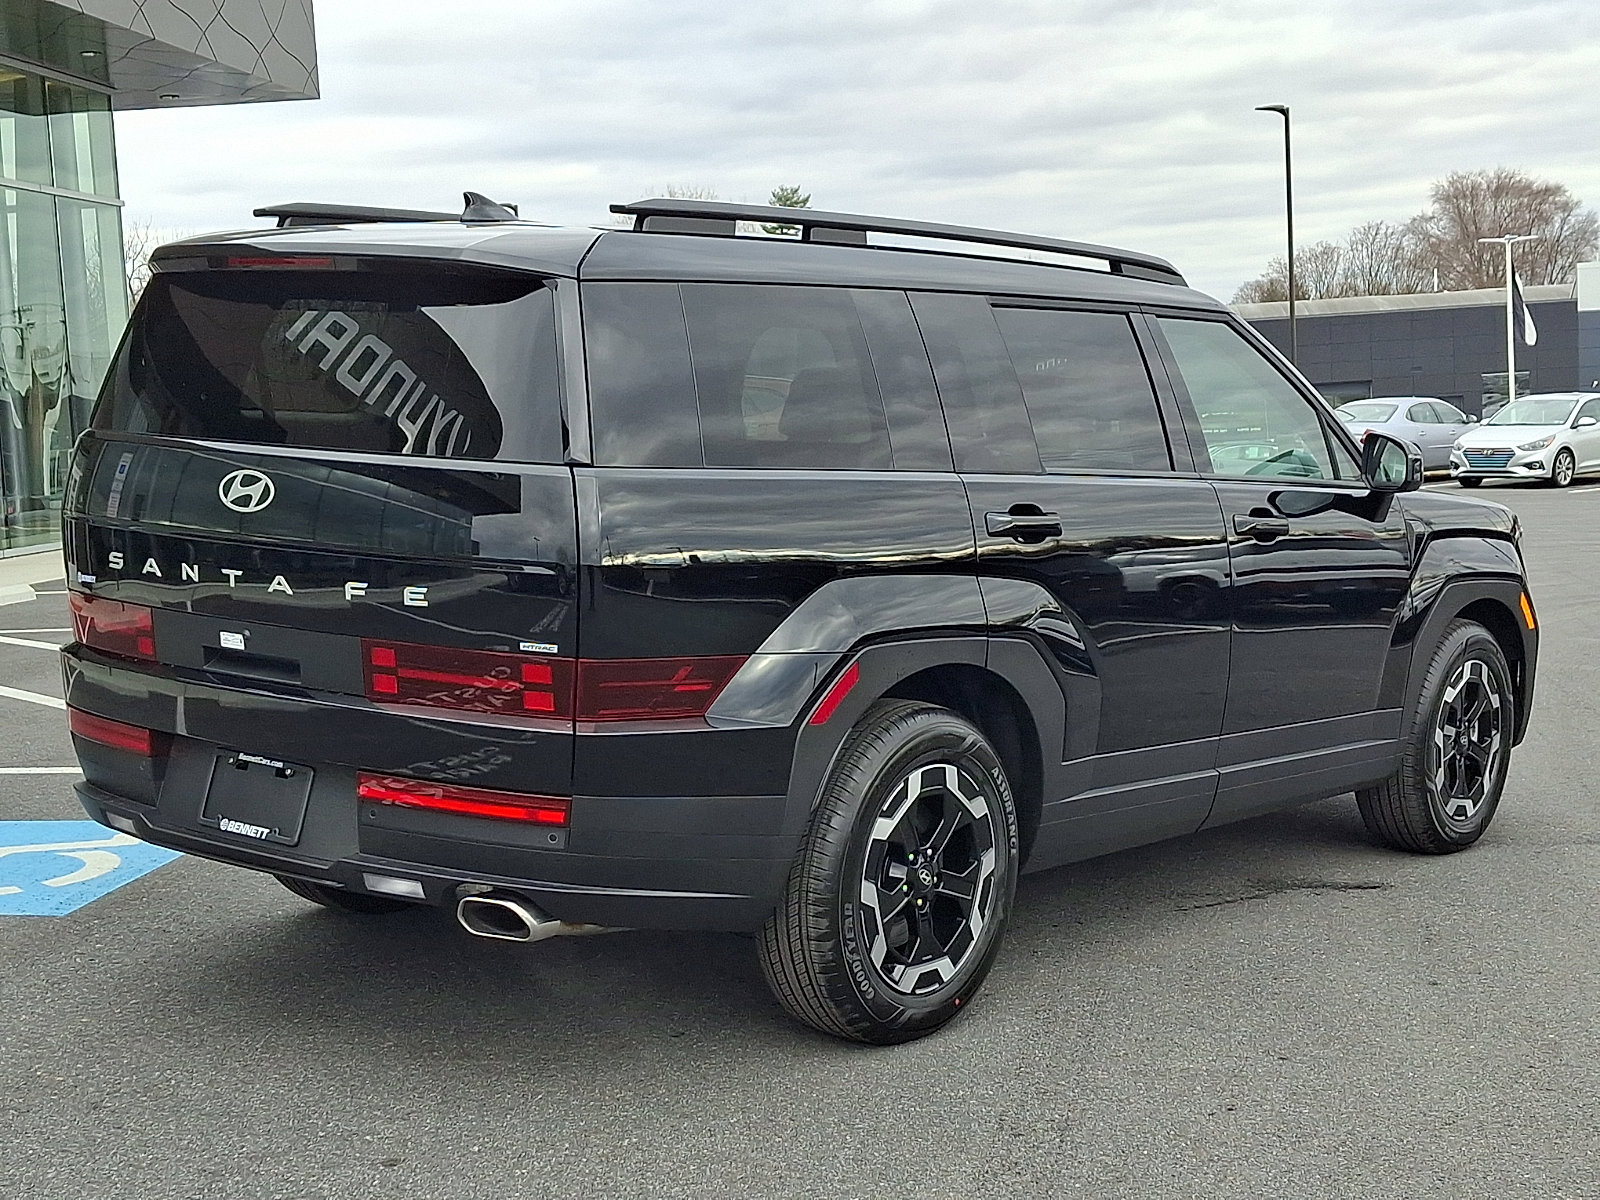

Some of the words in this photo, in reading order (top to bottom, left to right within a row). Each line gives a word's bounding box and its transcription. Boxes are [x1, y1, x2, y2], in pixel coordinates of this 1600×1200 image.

[108, 551, 294, 596] SANTA
[344, 581, 429, 607] FE
[521, 643, 557, 653] HTRAC
[226, 820, 271, 840] BENNETT
[991, 766, 1018, 857] ASSURANCE
